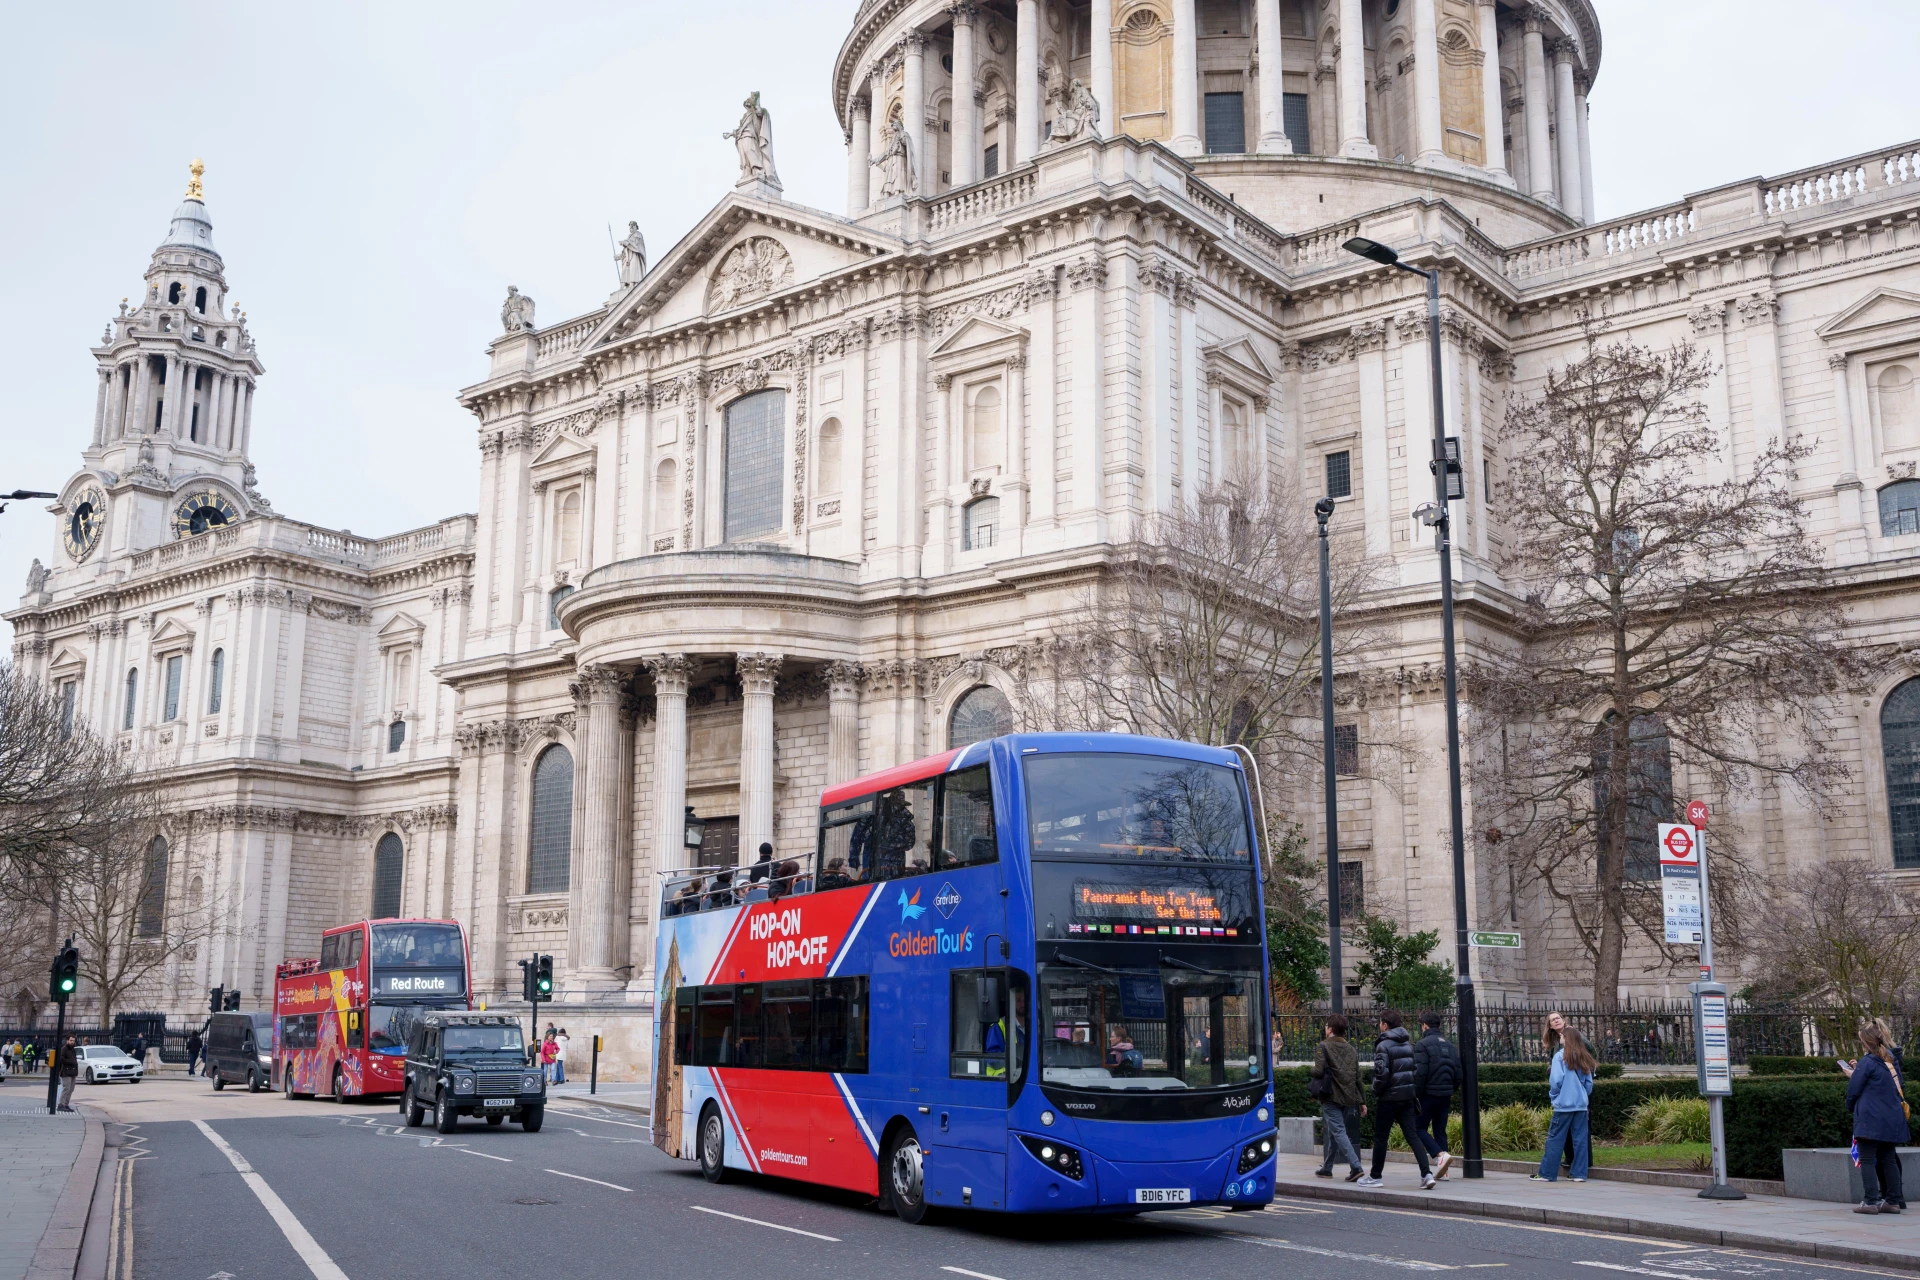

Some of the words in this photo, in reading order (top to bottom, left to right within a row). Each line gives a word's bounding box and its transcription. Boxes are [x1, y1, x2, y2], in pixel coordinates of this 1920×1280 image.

[1692, 808, 1705, 819] SK
[1083, 888, 1138, 904] Panoramic
[1140, 890, 1165, 905] Open
[1168, 892, 1186, 906] Top
[1190, 892, 1214, 906] Tour
[1156, 906, 1174, 918] See
[1179, 906, 1195, 918] the
[1200, 908, 1220, 920] sigh
[750, 908, 801, 940] HOP-ON
[767, 936, 828, 968] HOP-OFF
[392, 978, 412, 990] Red
[414, 978, 444, 990] Route
[760, 1148, 808, 1166] goldentours.com
[1142, 1190, 1162, 1201] BD16
[1166, 1190, 1184, 1201] YFC
